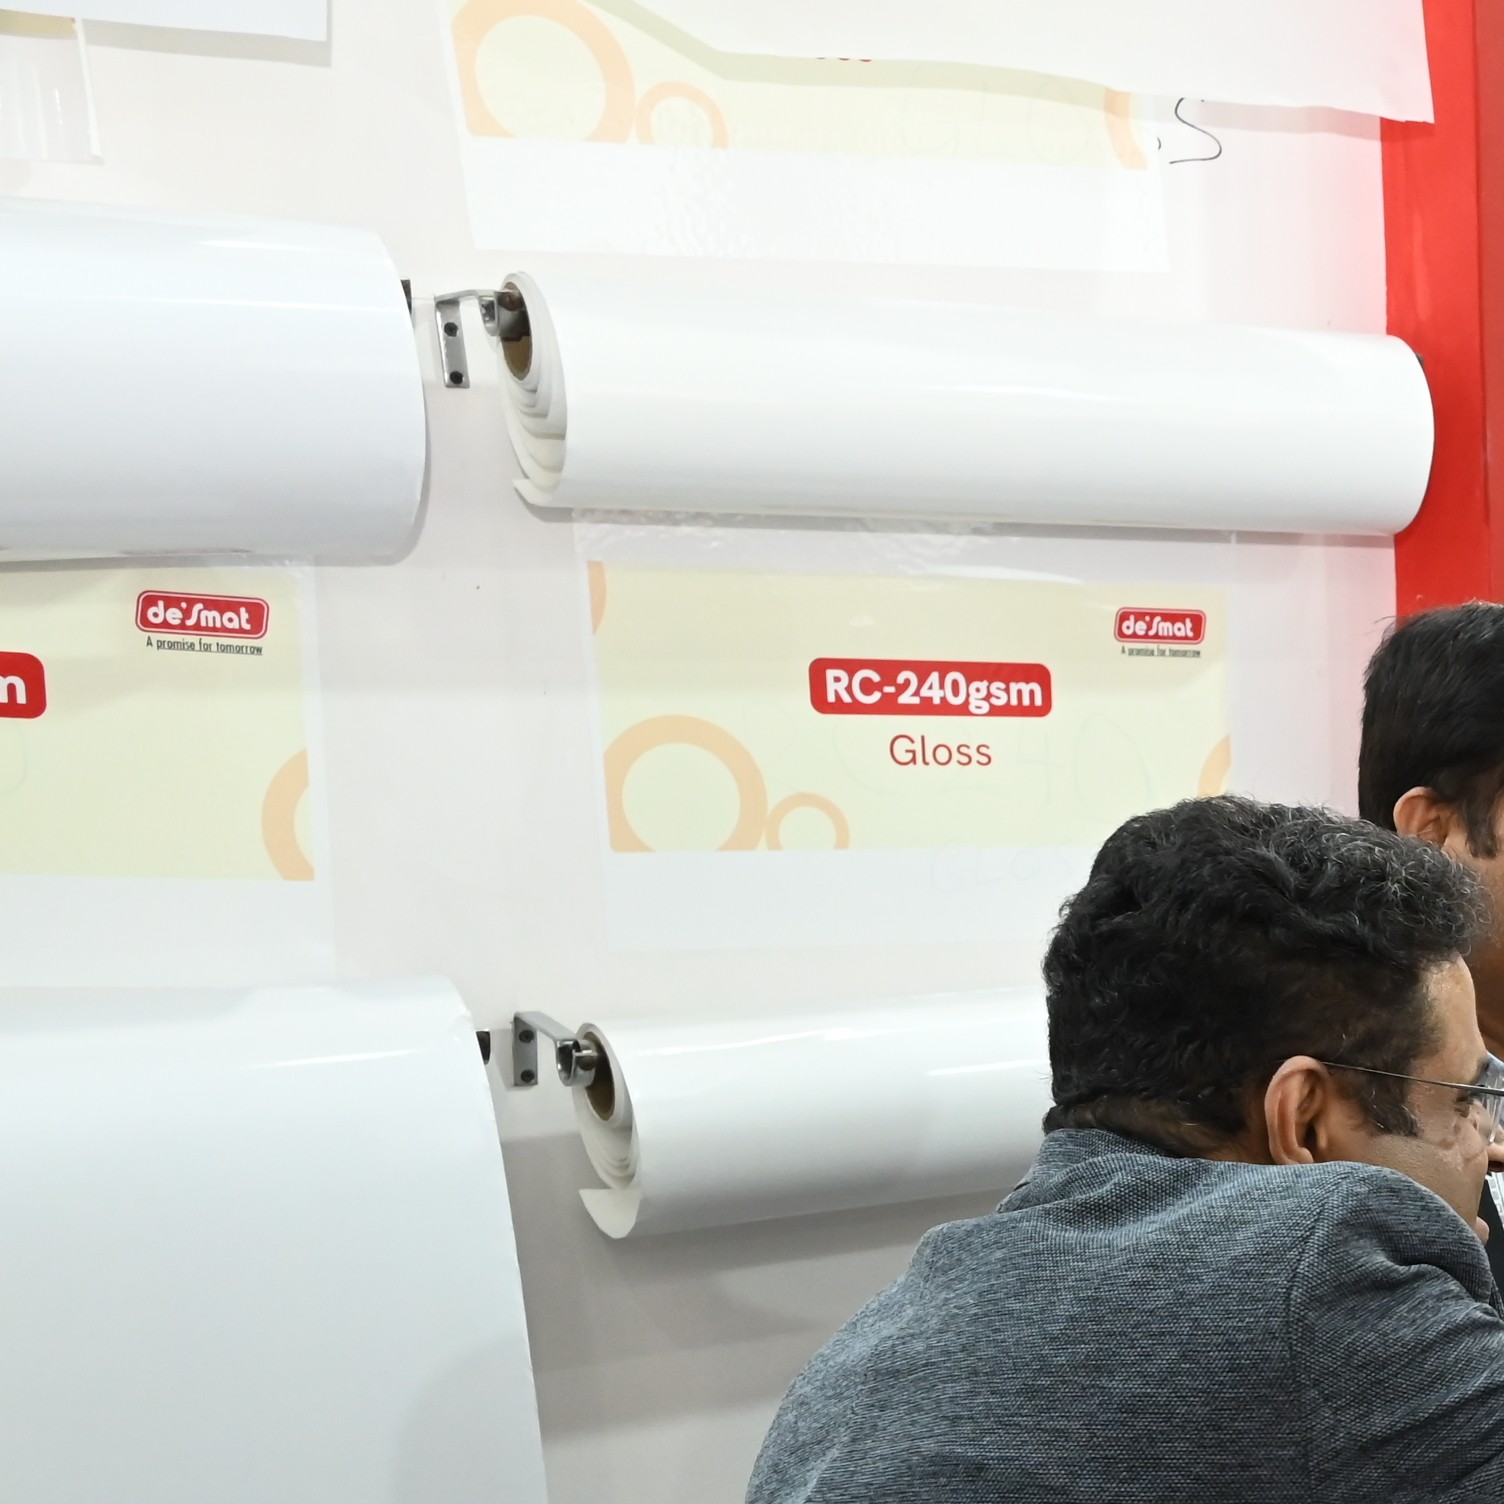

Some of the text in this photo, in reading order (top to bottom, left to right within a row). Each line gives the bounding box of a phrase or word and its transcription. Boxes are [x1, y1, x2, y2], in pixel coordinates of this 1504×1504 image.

[146, 636, 263, 655] A promise for tomorrow
[825, 668, 1042, 714] RC-240gsm
[889, 734, 992, 767] Gloss
